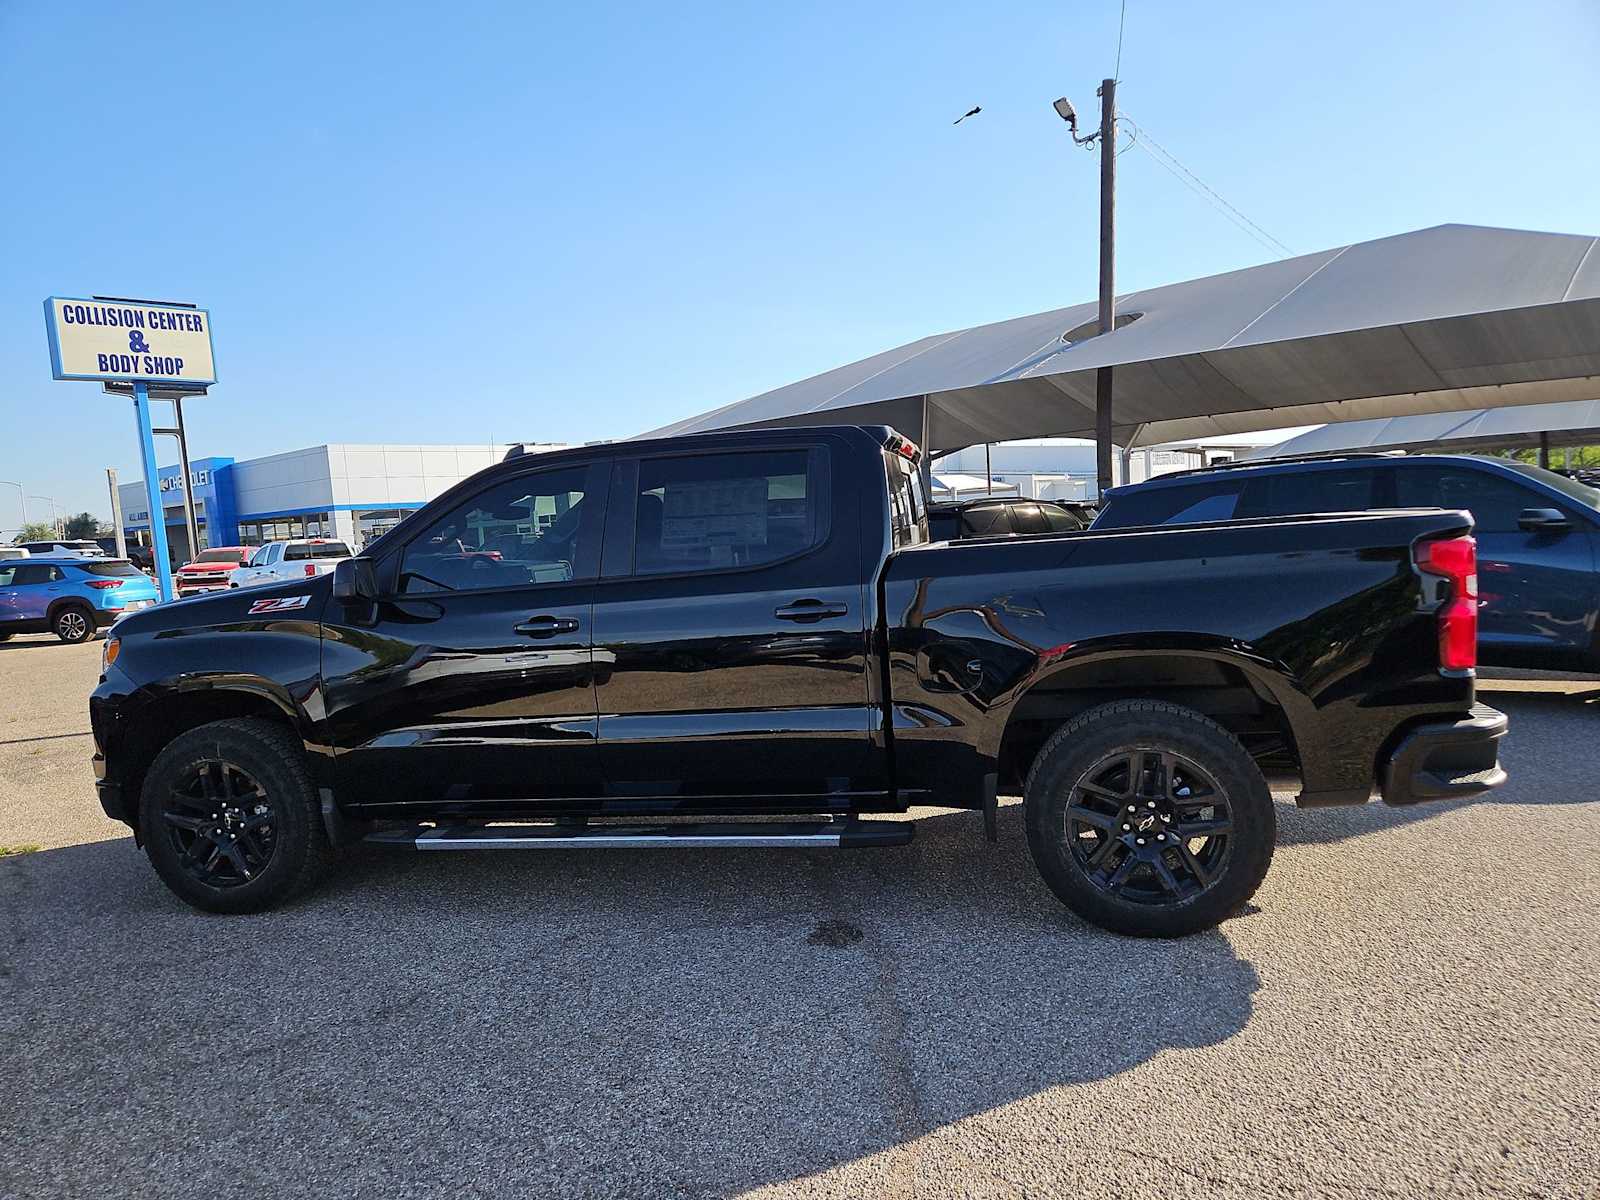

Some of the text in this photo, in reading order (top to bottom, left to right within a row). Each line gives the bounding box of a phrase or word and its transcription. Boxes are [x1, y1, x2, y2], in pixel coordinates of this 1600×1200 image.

[63, 304, 203, 332] COLLISION CENTER
[129, 330, 150, 353] &
[97, 353, 184, 375] BODY SHOP
[168, 470, 208, 490] CHEOLET
[248, 595, 312, 614] Z71
